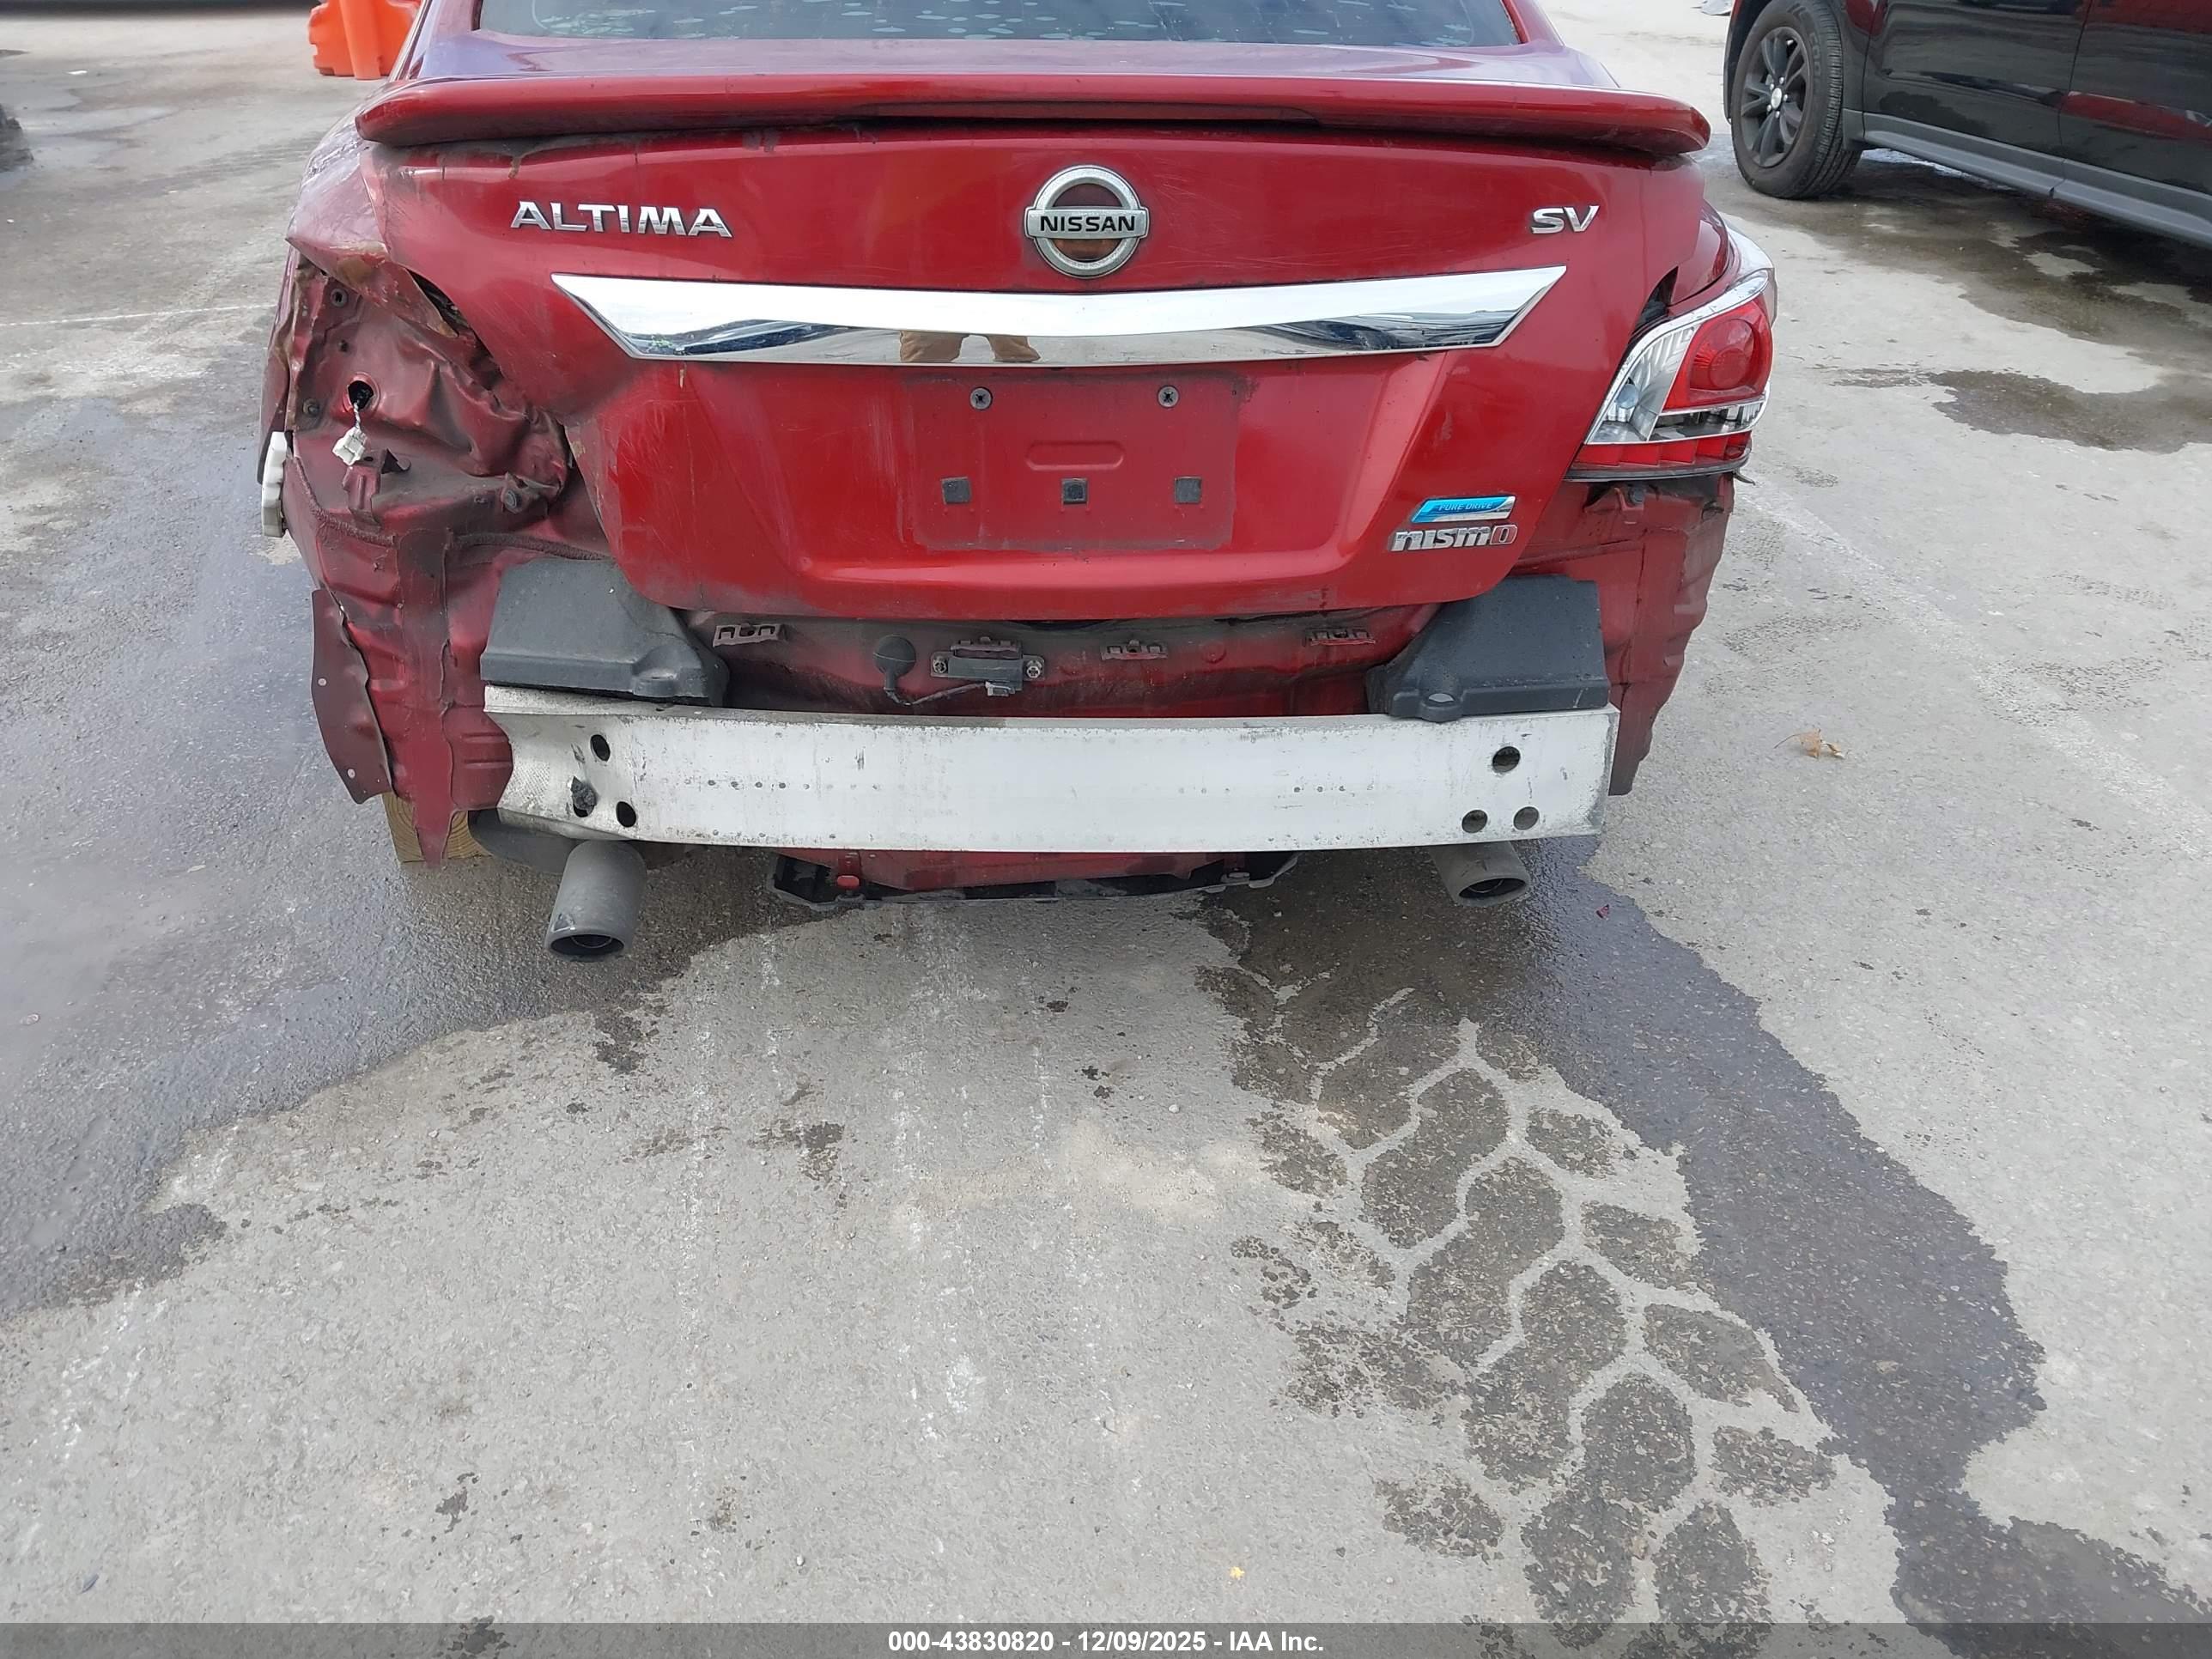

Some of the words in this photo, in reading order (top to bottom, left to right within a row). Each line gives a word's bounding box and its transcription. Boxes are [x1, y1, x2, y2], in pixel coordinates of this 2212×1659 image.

[510, 200, 733, 238] ALTIMA
[1040, 216, 1135, 232] NISSAN
[1530, 205, 1601, 234] SV
[1438, 502, 1464, 512] PURE
[1465, 501, 1493, 511] DRIVE
